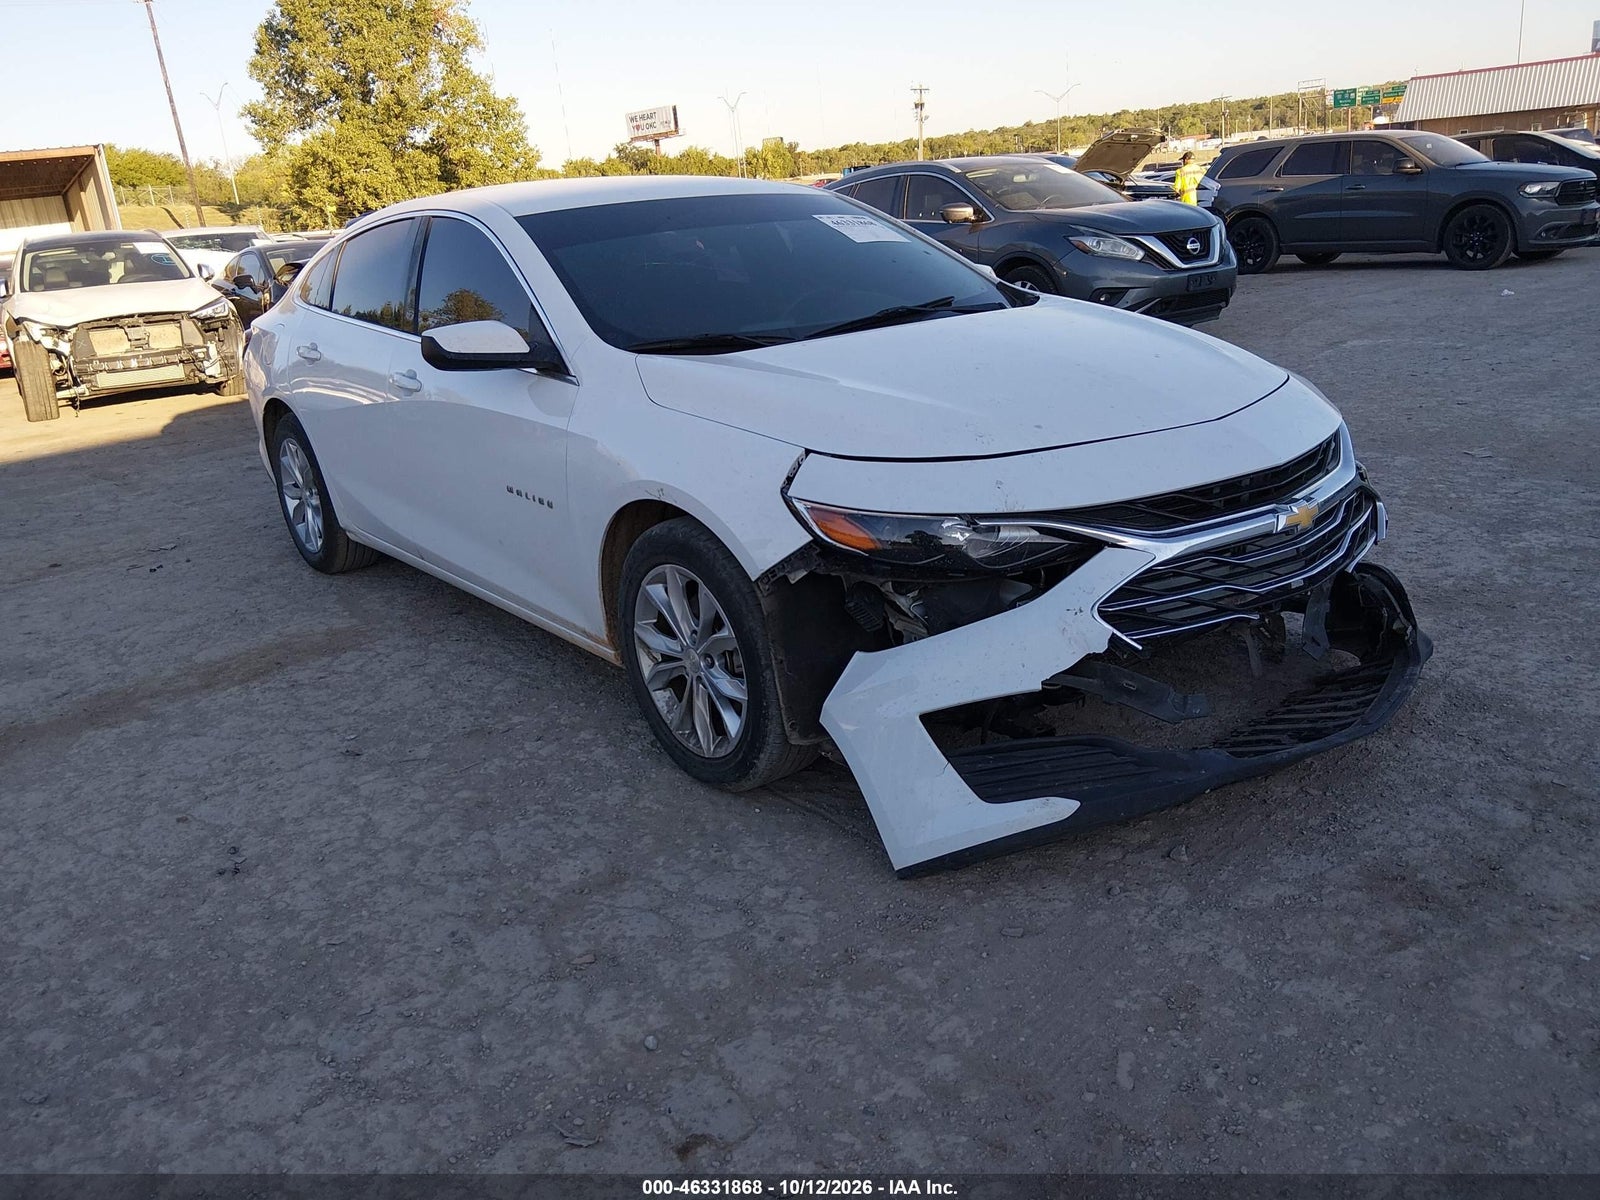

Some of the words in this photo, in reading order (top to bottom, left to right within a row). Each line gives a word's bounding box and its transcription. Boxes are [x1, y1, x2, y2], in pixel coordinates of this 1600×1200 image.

[629, 115, 639, 123] WE
[639, 112, 657, 121] HEART
[645, 121, 657, 130] OKC
[506, 485, 553, 509] MALIBU
